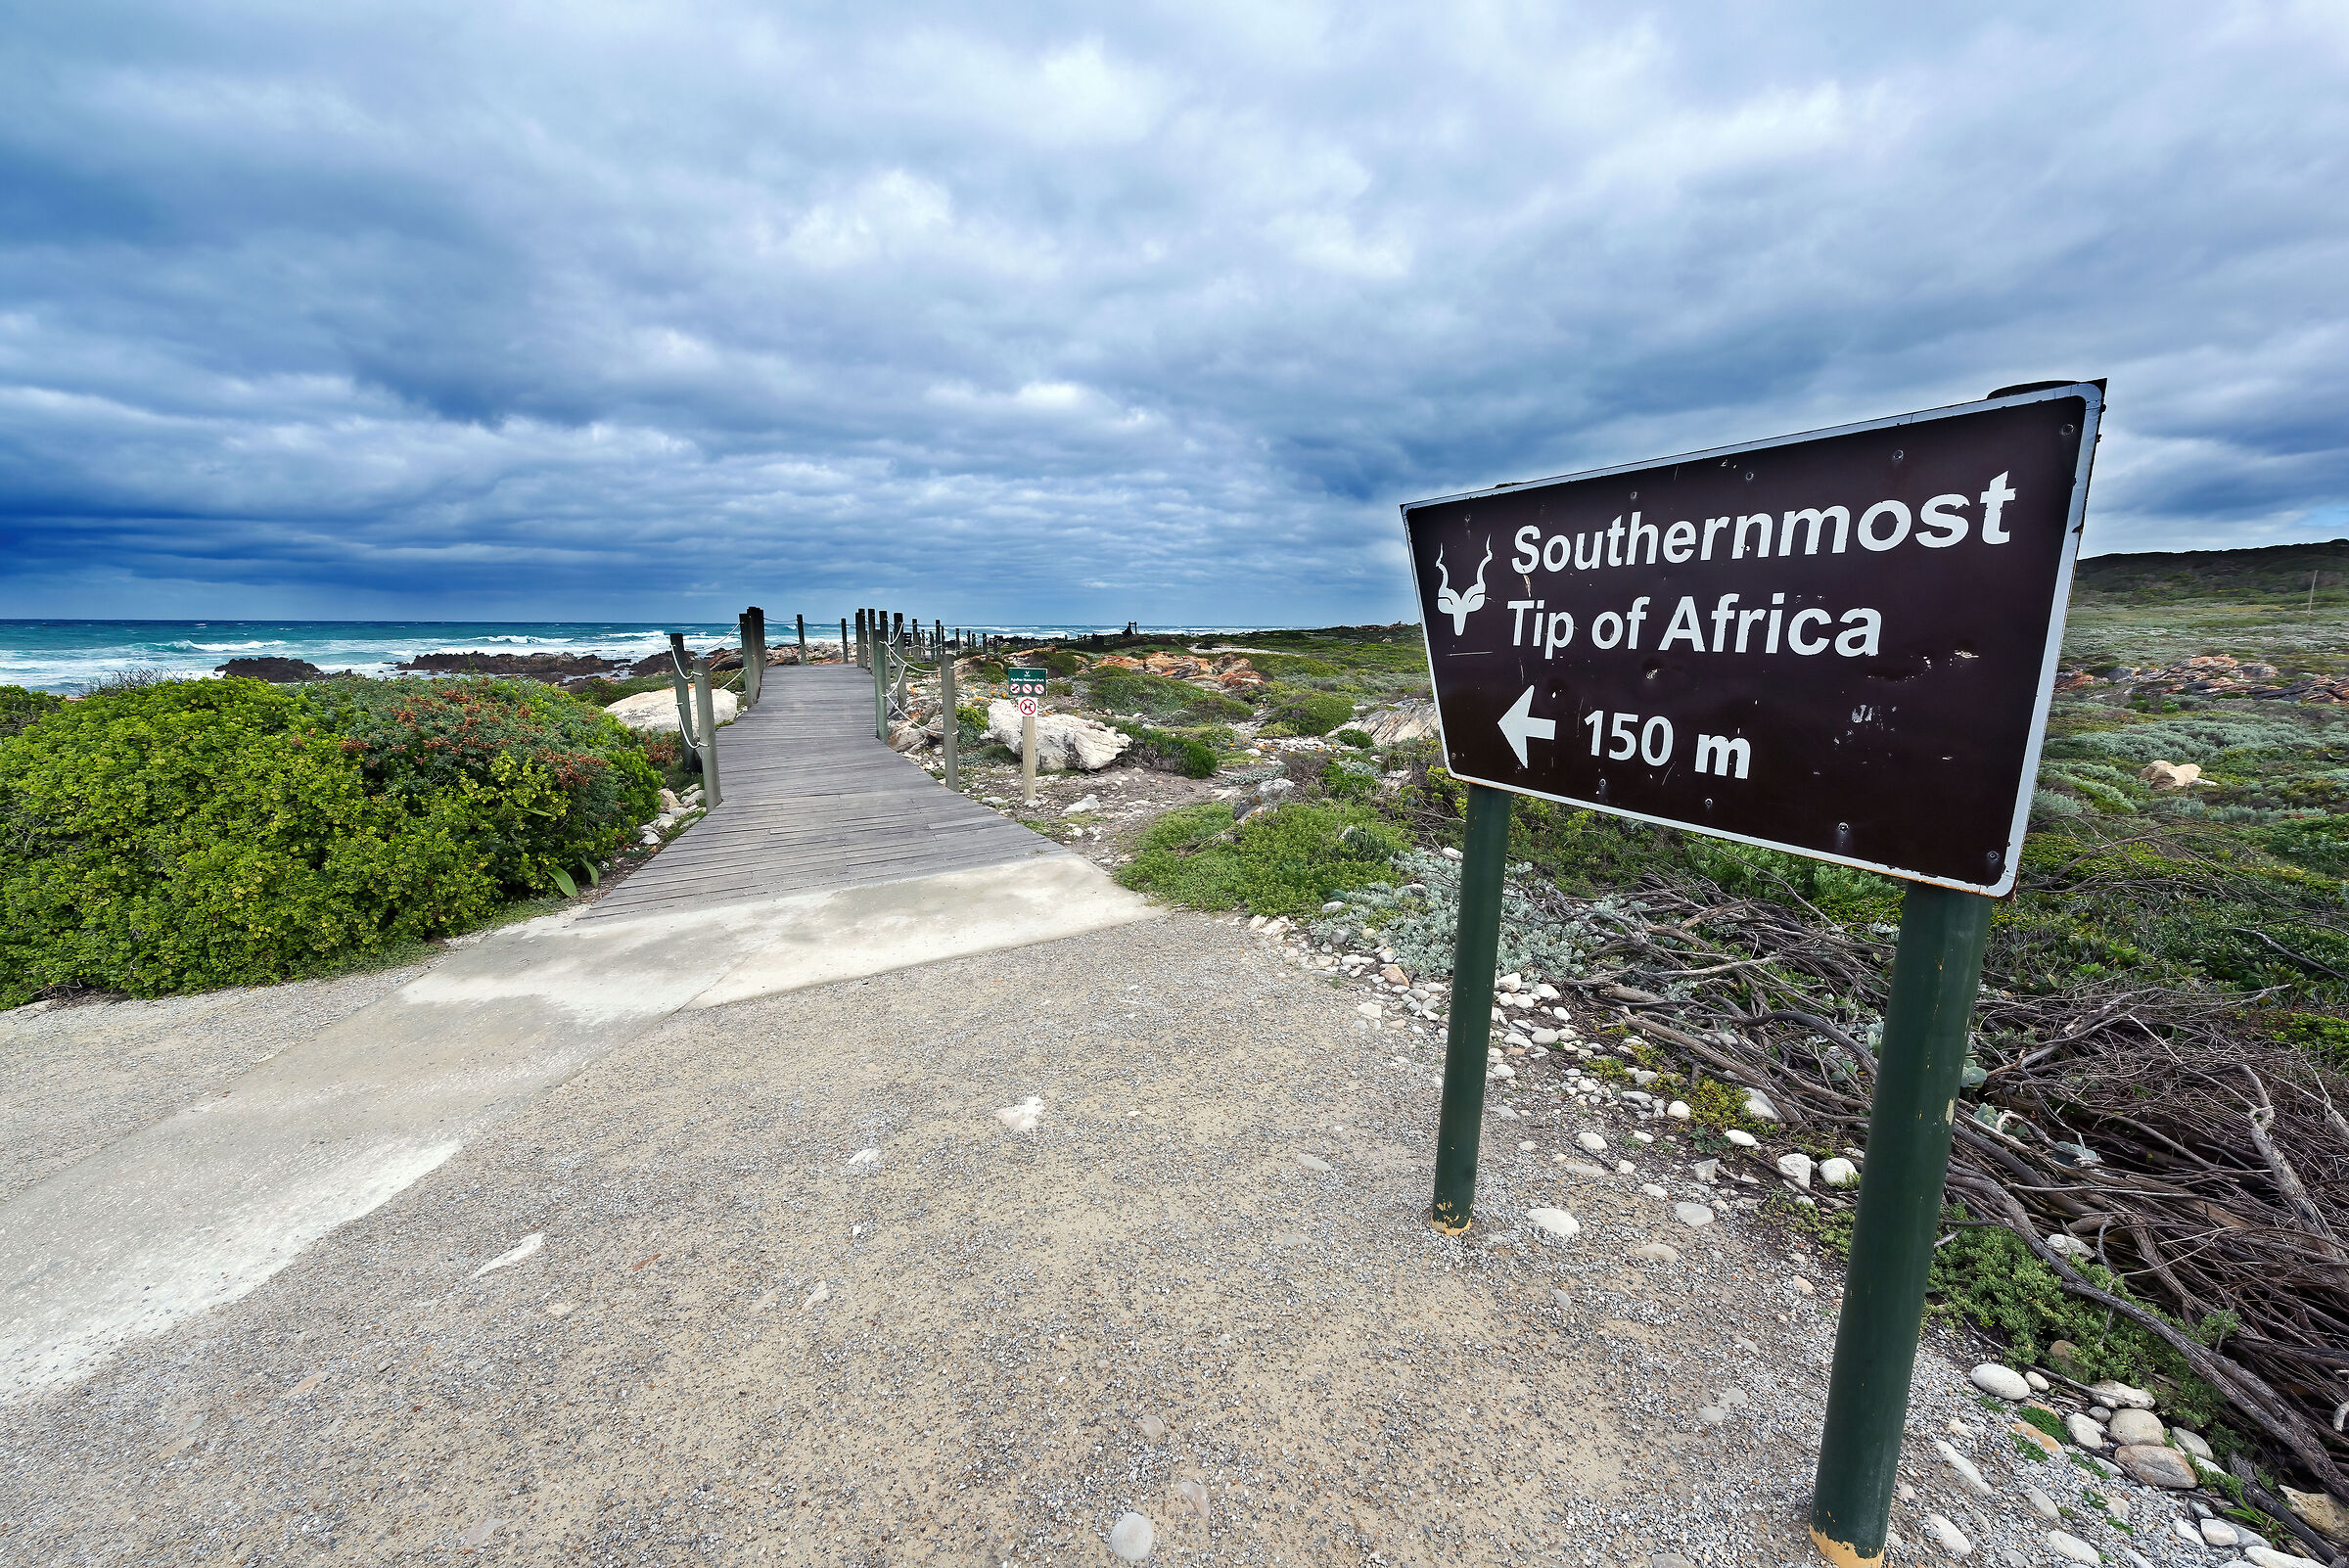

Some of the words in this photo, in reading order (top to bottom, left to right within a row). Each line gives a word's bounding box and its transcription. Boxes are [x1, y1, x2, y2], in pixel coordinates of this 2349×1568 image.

[1511, 471, 2016, 576] Southernmost
[1507, 597, 1575, 660] Tip
[1592, 597, 1650, 650] of
[1658, 593, 1881, 658] Africa
[1585, 711, 1673, 766] 150
[1695, 734, 1751, 780] m
